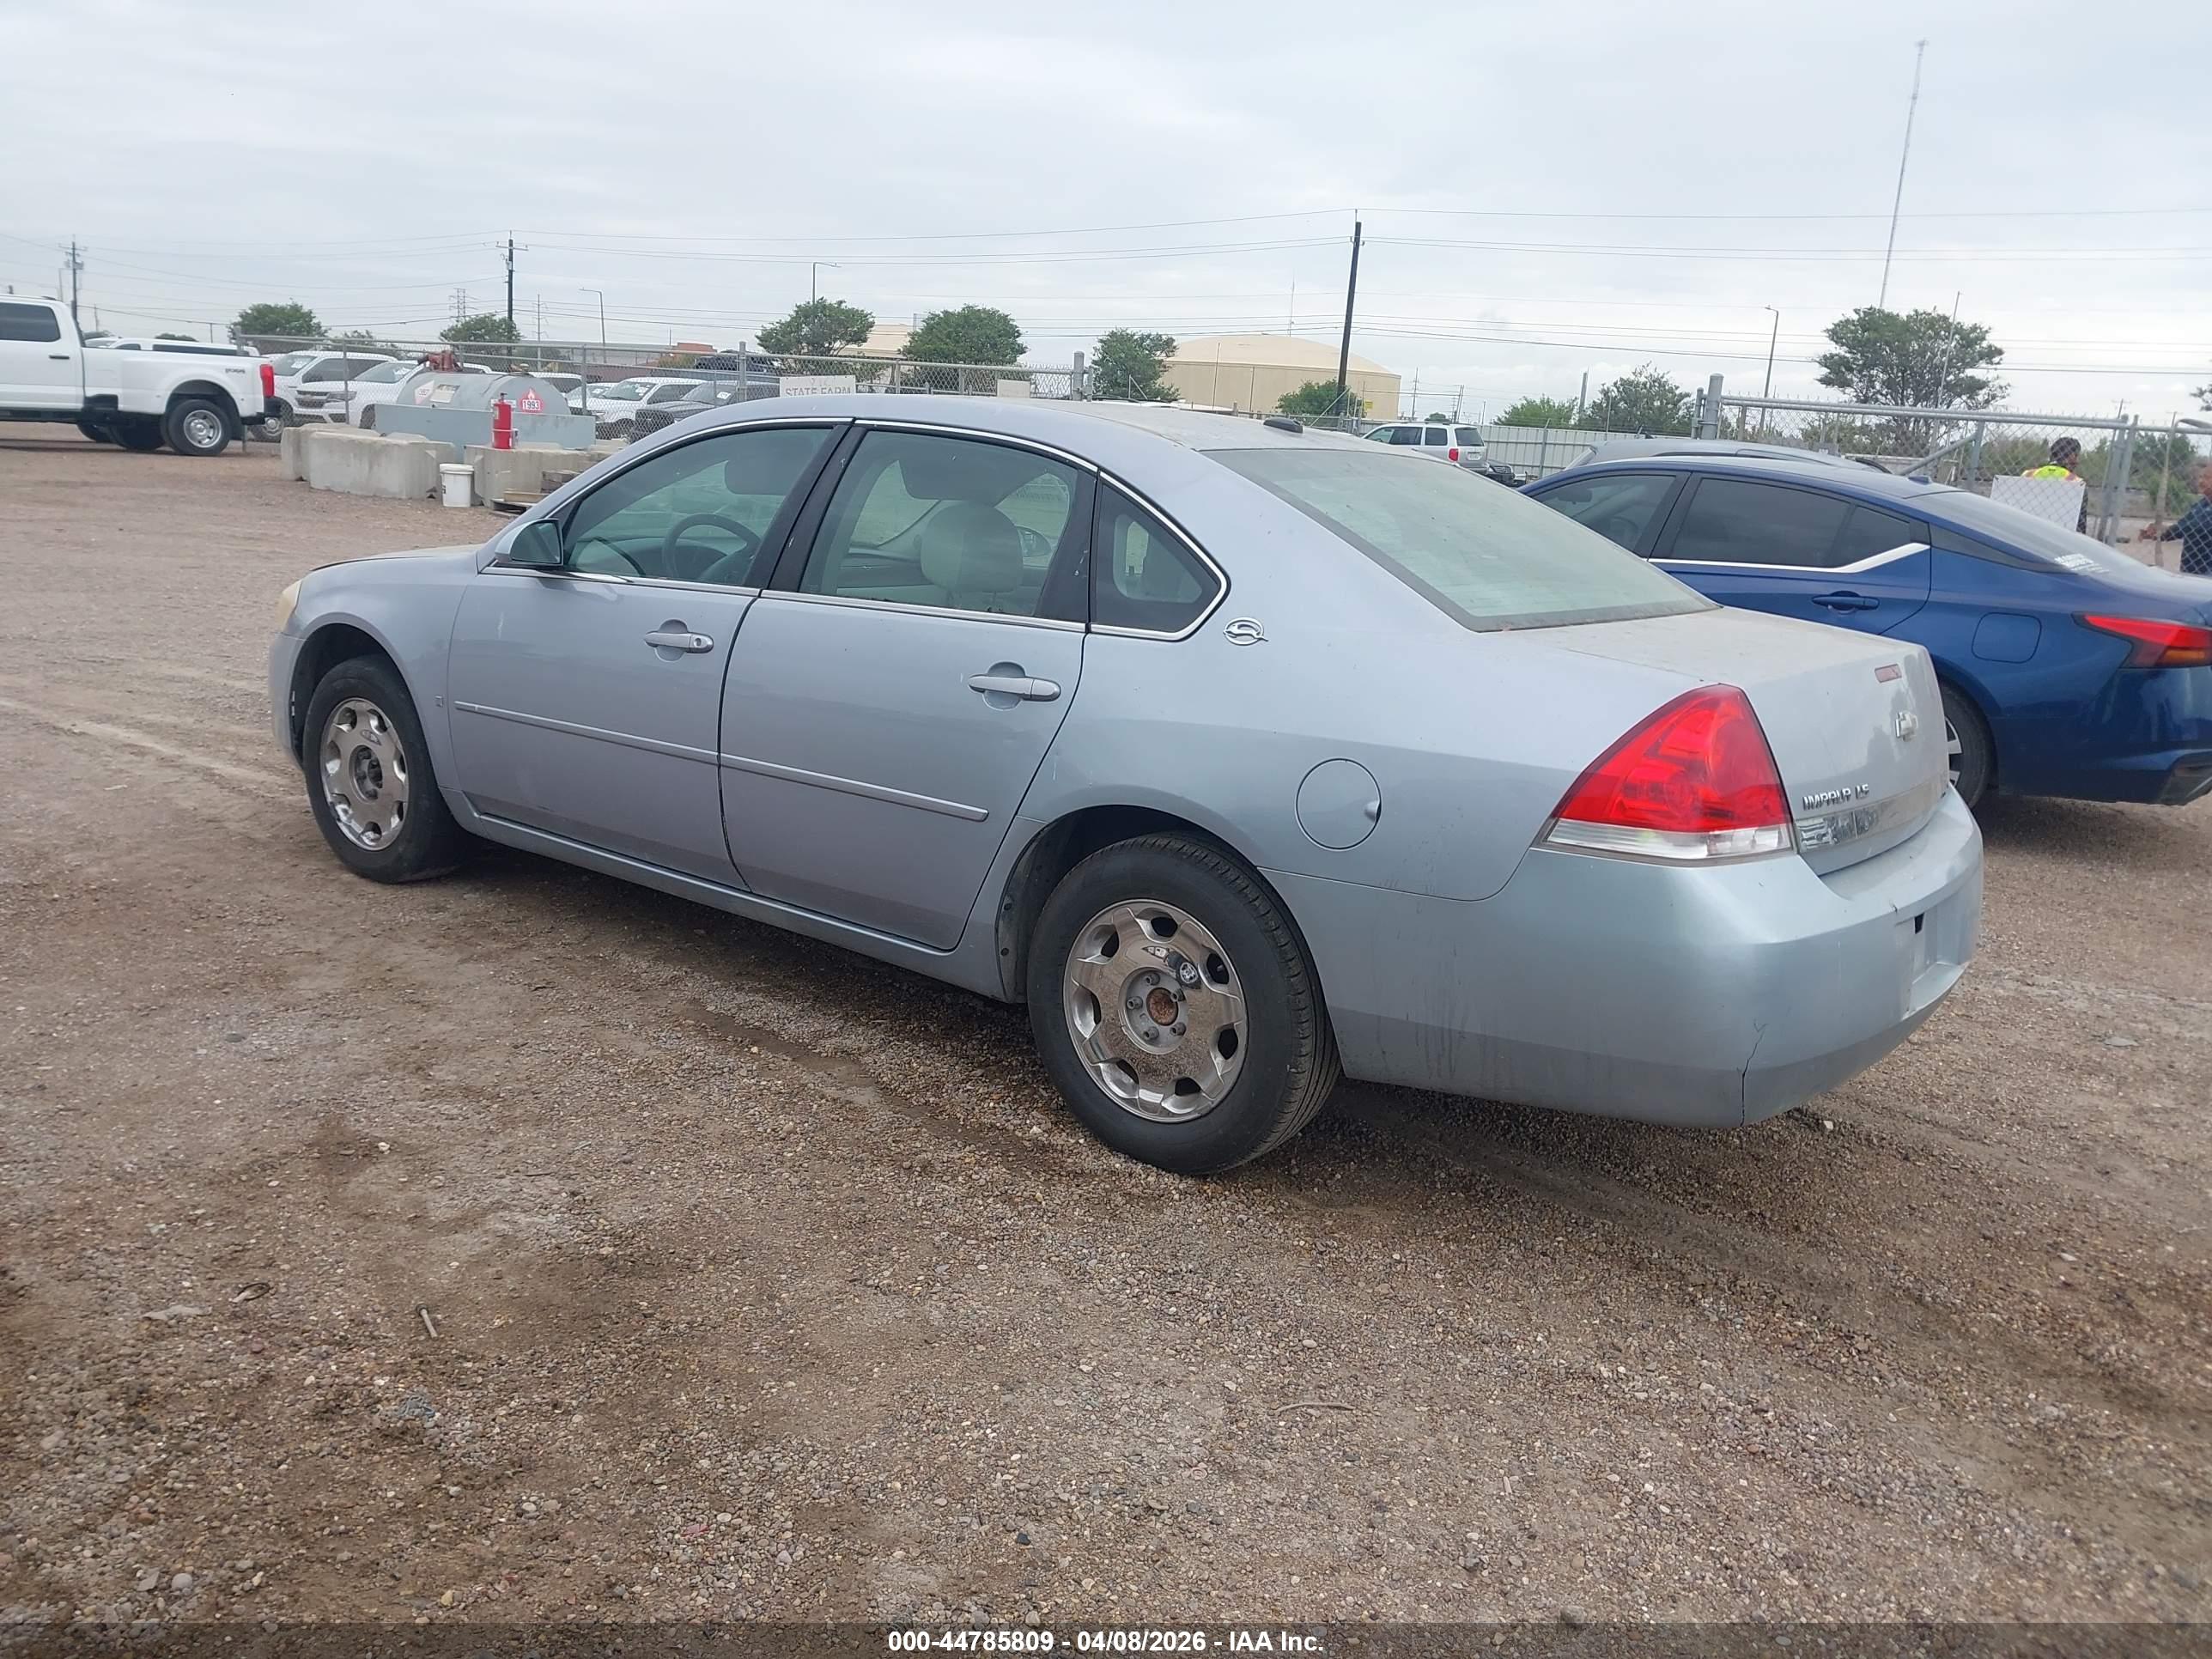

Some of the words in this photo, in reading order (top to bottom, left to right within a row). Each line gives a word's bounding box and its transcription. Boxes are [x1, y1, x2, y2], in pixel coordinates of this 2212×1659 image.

[785, 386, 817, 397] STATE
[820, 386, 851, 395] FARM
[523, 400, 540, 410] 1993
